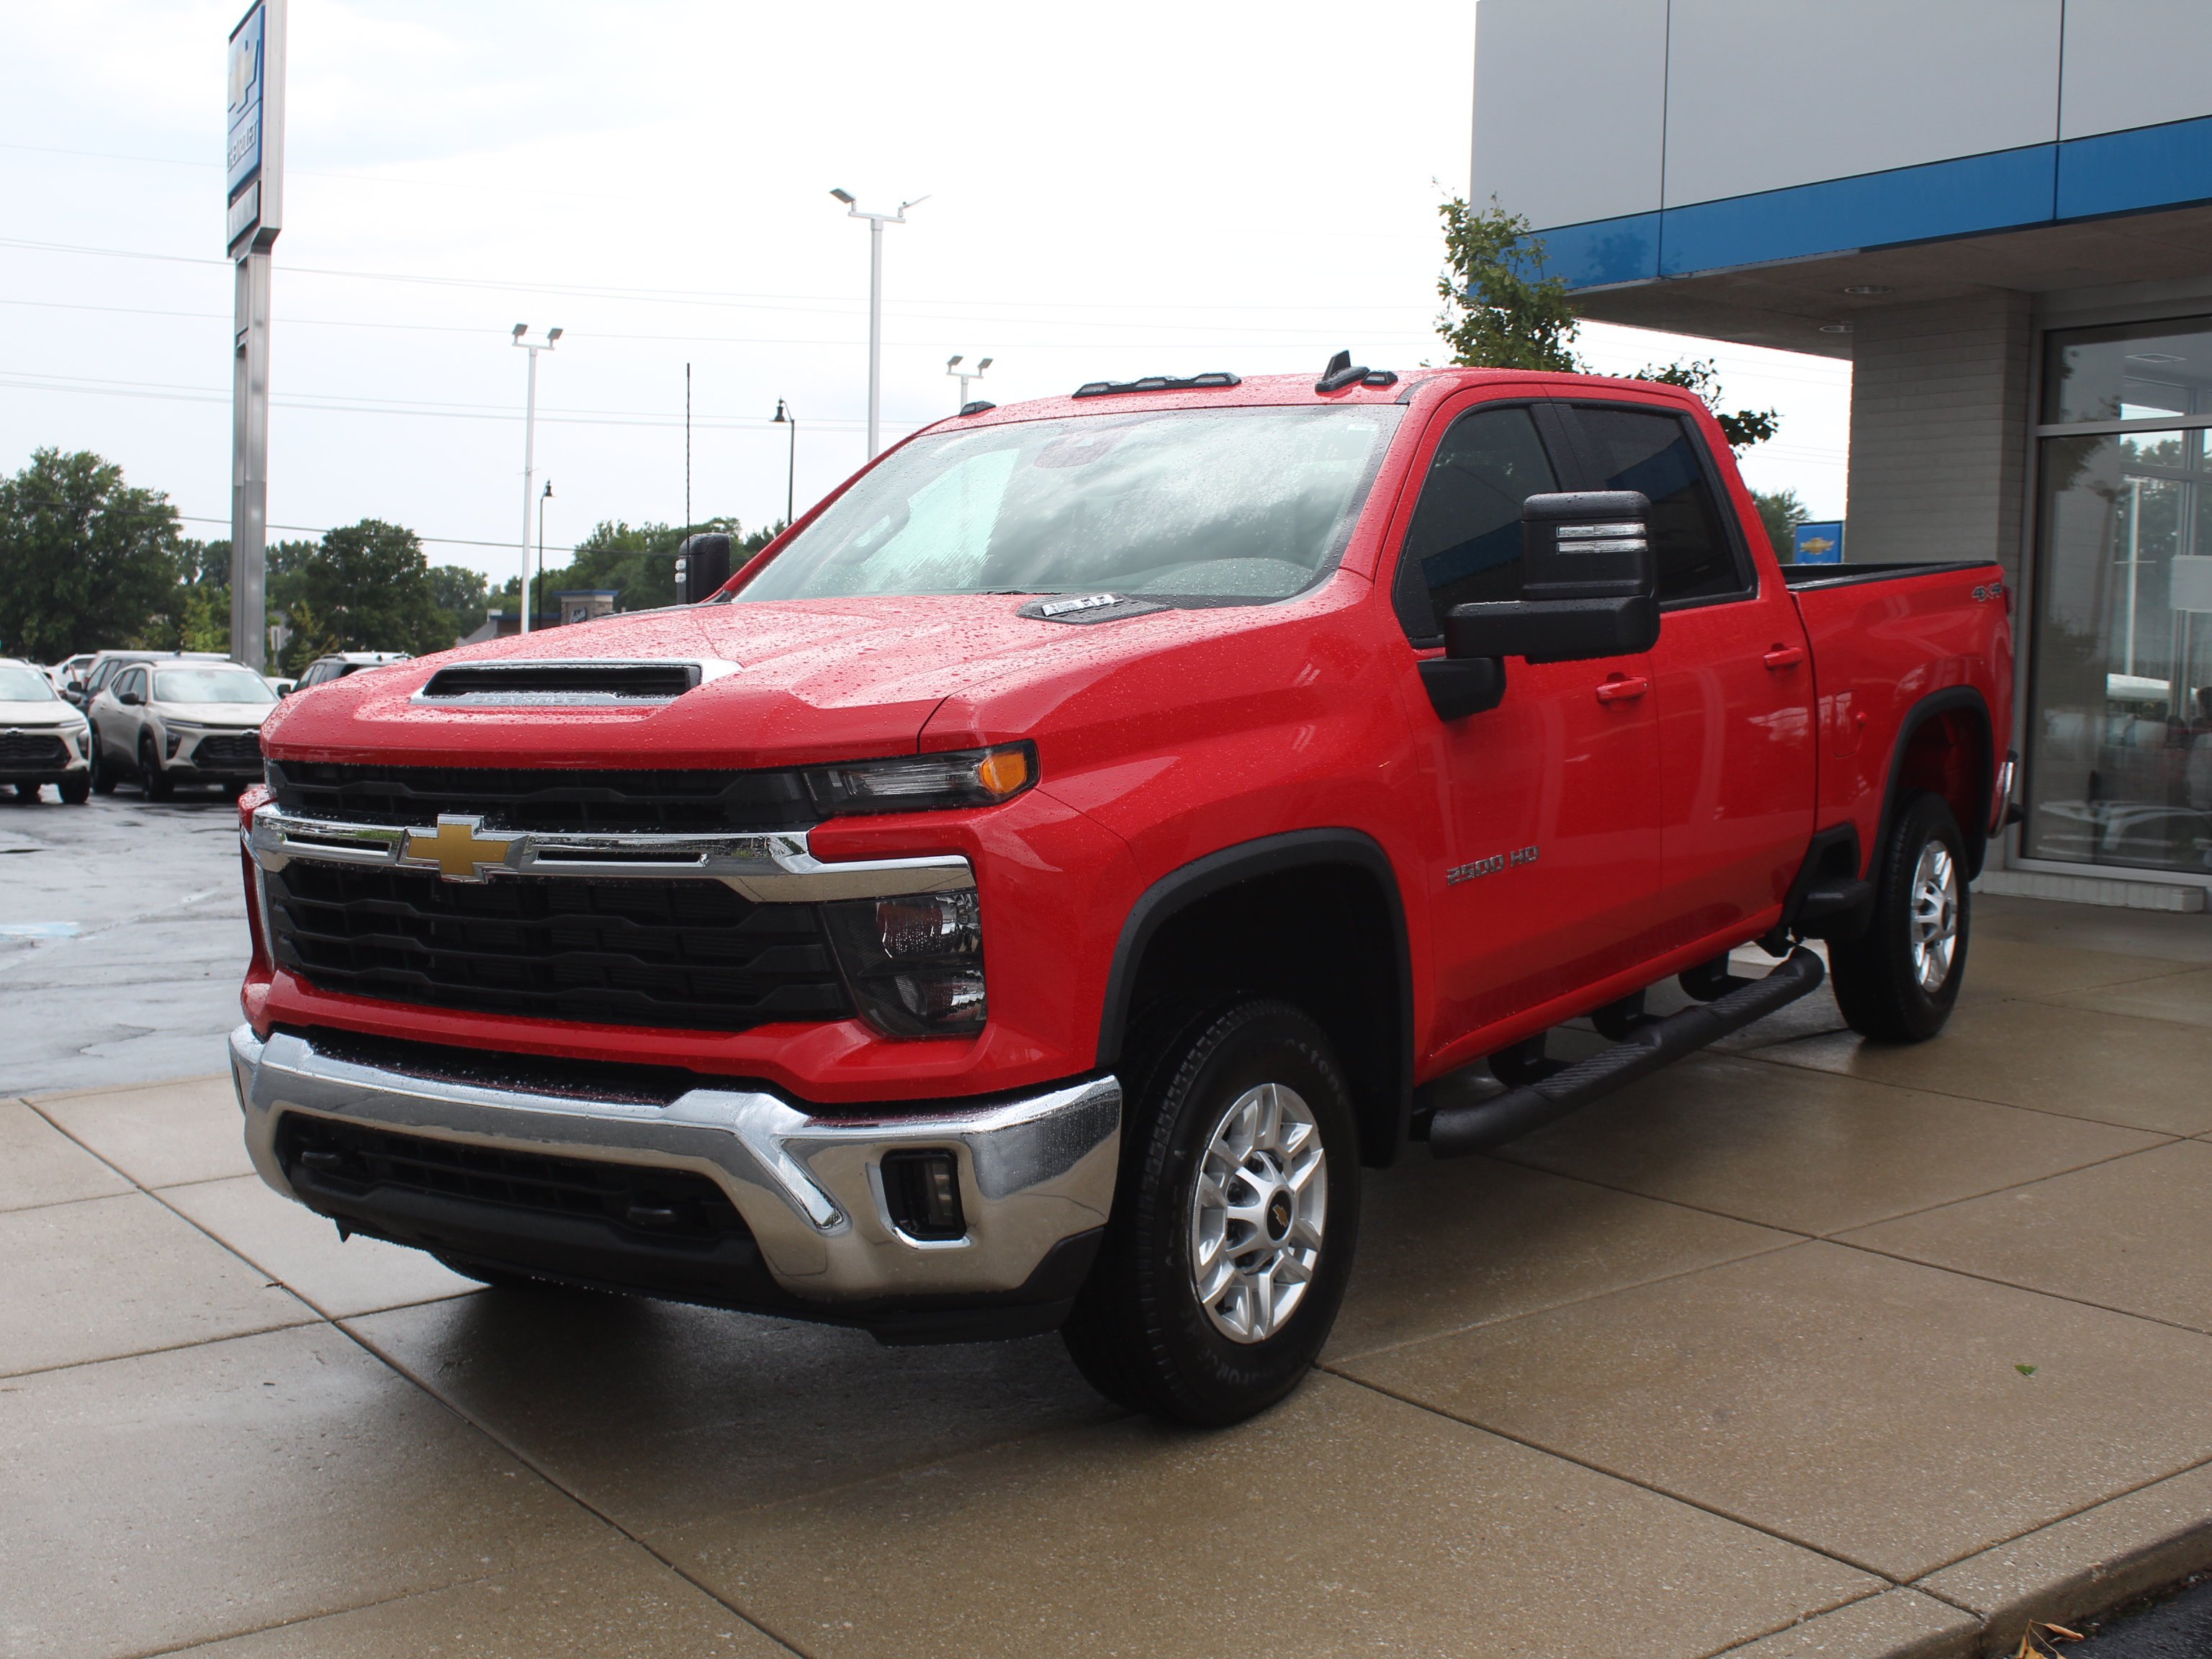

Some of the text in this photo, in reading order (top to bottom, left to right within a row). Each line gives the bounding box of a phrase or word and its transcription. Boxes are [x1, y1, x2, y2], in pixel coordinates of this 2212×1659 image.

[471, 694, 594, 704] CHEVROLET
[1446, 845, 1539, 886] 2500 HD
